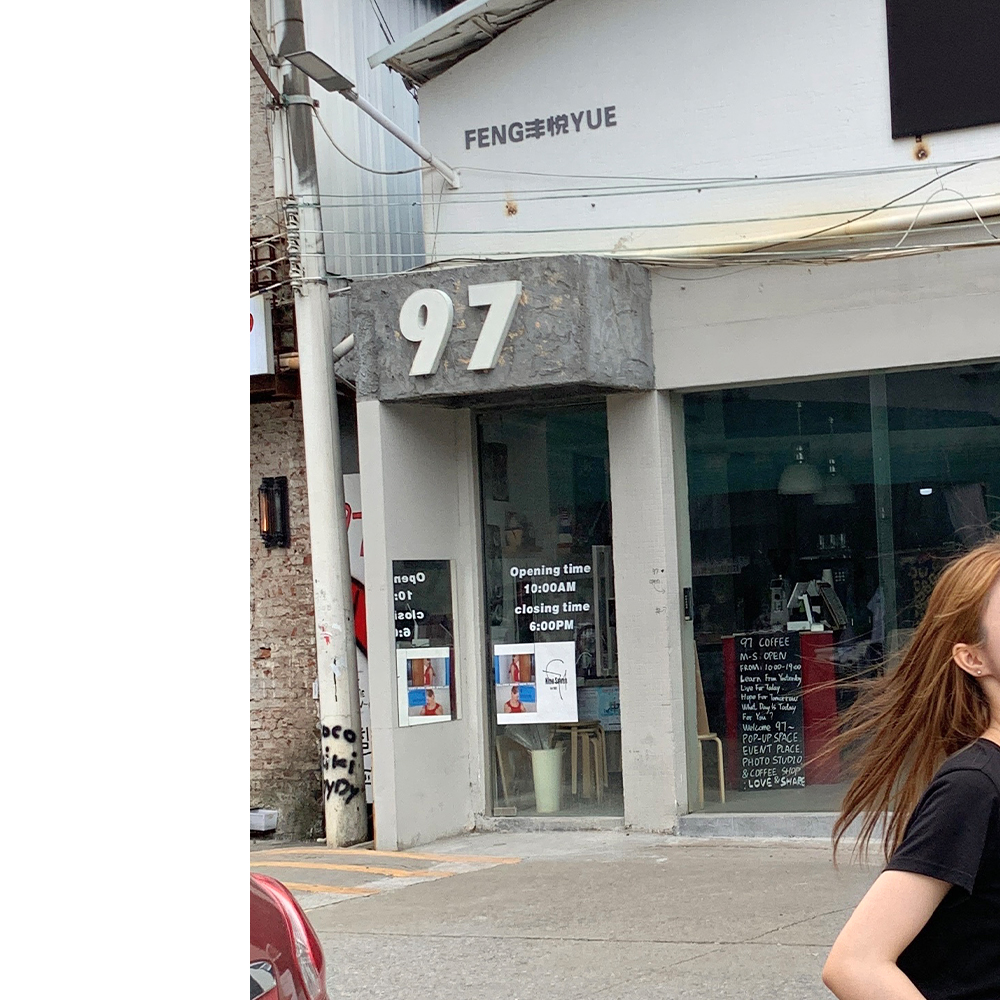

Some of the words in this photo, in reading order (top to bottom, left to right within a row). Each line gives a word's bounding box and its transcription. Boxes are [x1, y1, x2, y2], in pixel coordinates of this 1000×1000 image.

[399, 280, 522, 376] 97
[510, 564, 561, 579] Opening
[563, 563, 591, 574] time
[524, 581, 576, 594] 10:00AM
[514, 603, 560, 615] closing
[562, 601, 590, 612] time
[529, 619, 574, 632] 6:00PM
[740, 637, 753, 648] 97
[759, 636, 790, 647] COFFEE
[763, 651, 787, 660] OPEN
[740, 674, 761, 682] Learn
[778, 703, 797, 715] Today
[742, 723, 772, 732] Welcome
[742, 733, 773, 744] POP-UP
[773, 732, 799, 743] SPACE
[742, 757, 771, 767] PHOTO
